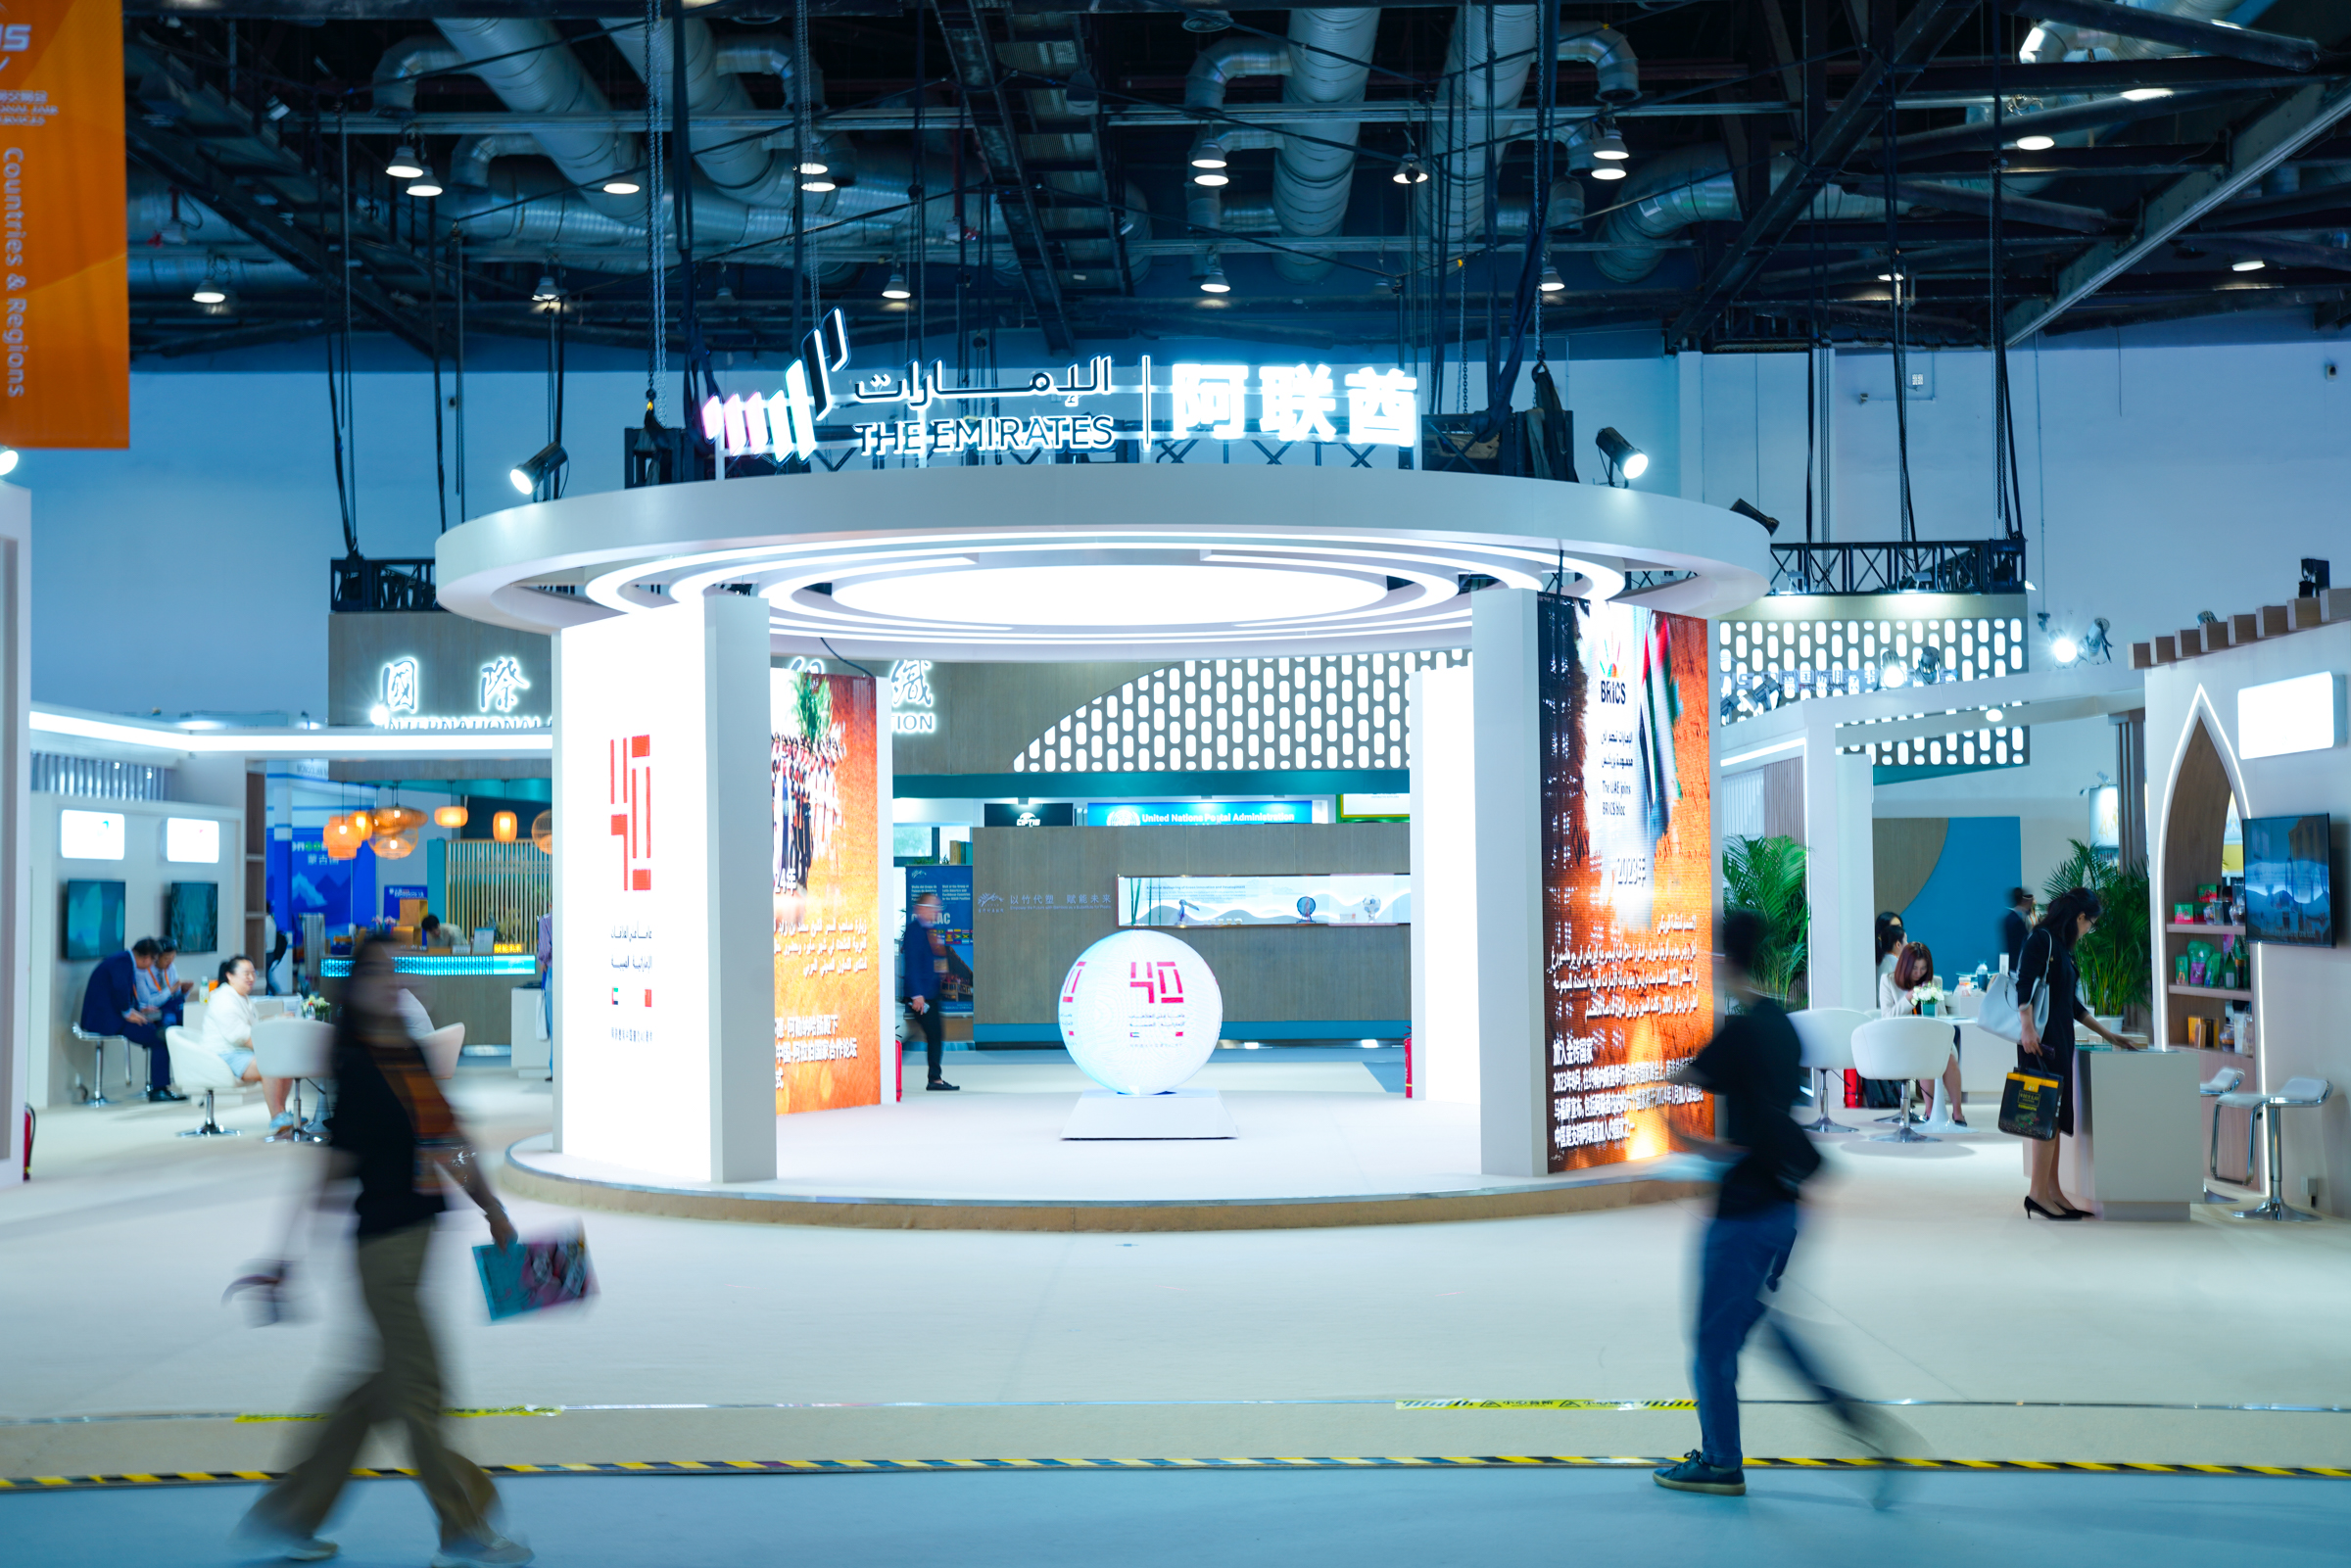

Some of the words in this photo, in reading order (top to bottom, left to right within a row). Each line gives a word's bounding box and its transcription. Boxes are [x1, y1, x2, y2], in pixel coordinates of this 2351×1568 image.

[3, 147, 24, 267] Countries
[6, 273, 27, 292] &
[3, 298, 27, 399] Regions
[855, 354, 1114, 414] الإمارات
[1171, 362, 1418, 448] 阿联酋
[852, 421, 925, 456] THE
[930, 413, 1116, 453] EMIRATES
[1610, 780, 1619, 794] UAE
[1620, 780, 1631, 798] joins
[1142, 814, 1170, 823] United
[1172, 814, 1203, 823] Nations
[1205, 813, 1231, 822] Potal
[1233, 813, 1295, 822] Administration
[1603, 801, 1615, 816] BRICS
[1010, 894, 1054, 905] 以竹代塑
[911, 912, 950, 926] CLAC
